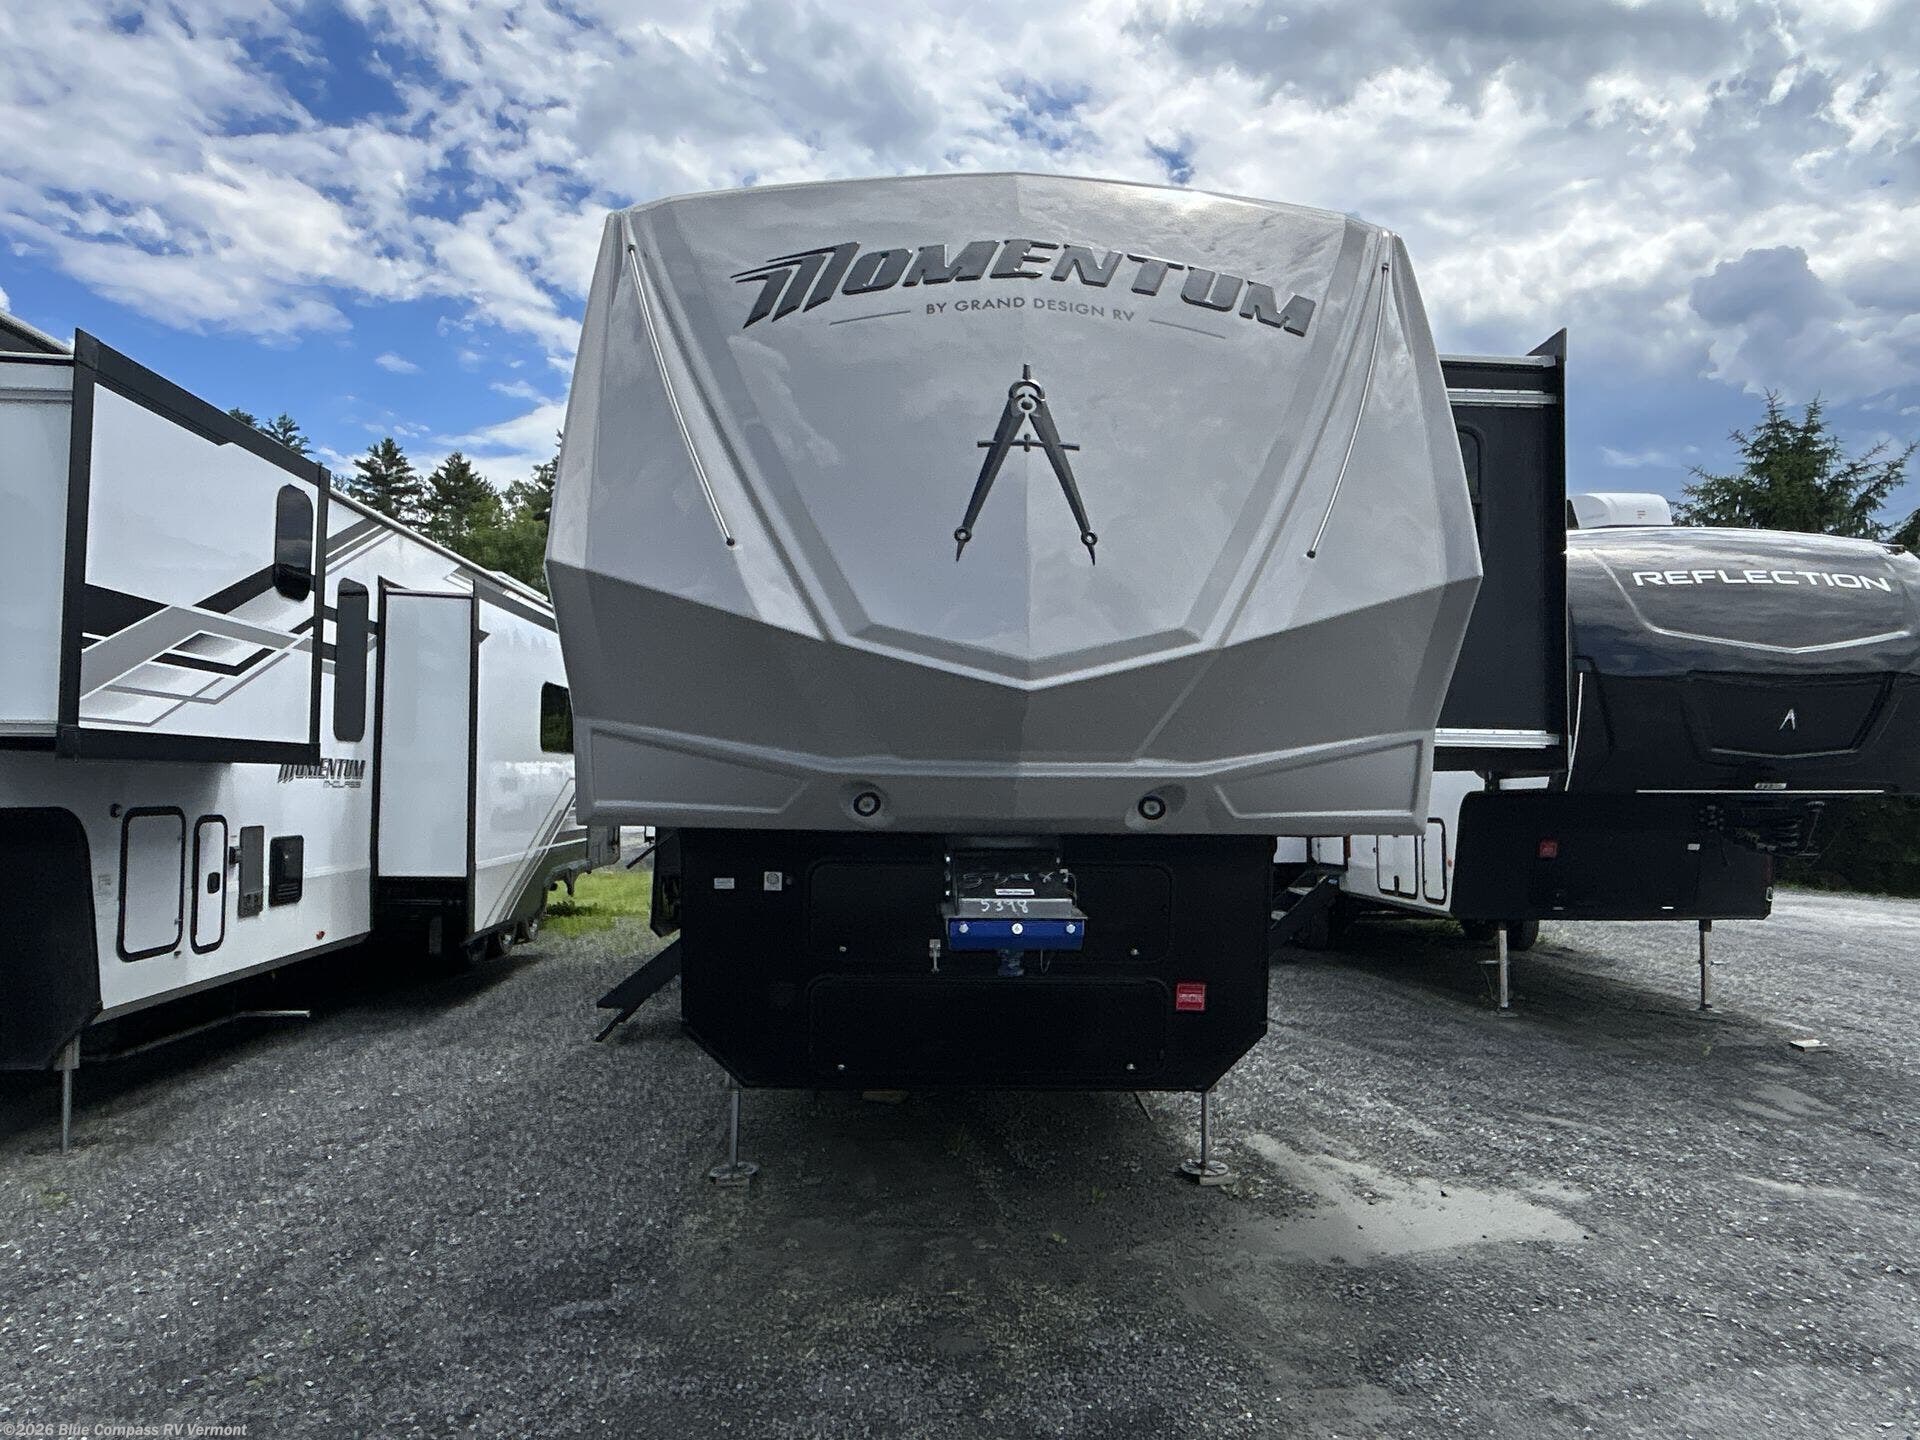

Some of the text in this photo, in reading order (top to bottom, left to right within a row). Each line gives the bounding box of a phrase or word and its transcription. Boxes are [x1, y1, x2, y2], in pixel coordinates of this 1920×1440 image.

[730, 239, 1317, 338] MOMENTUM
[925, 296, 1135, 322] BY GRAND DESIGN RV
[1632, 569, 1892, 593] REFLECTION
